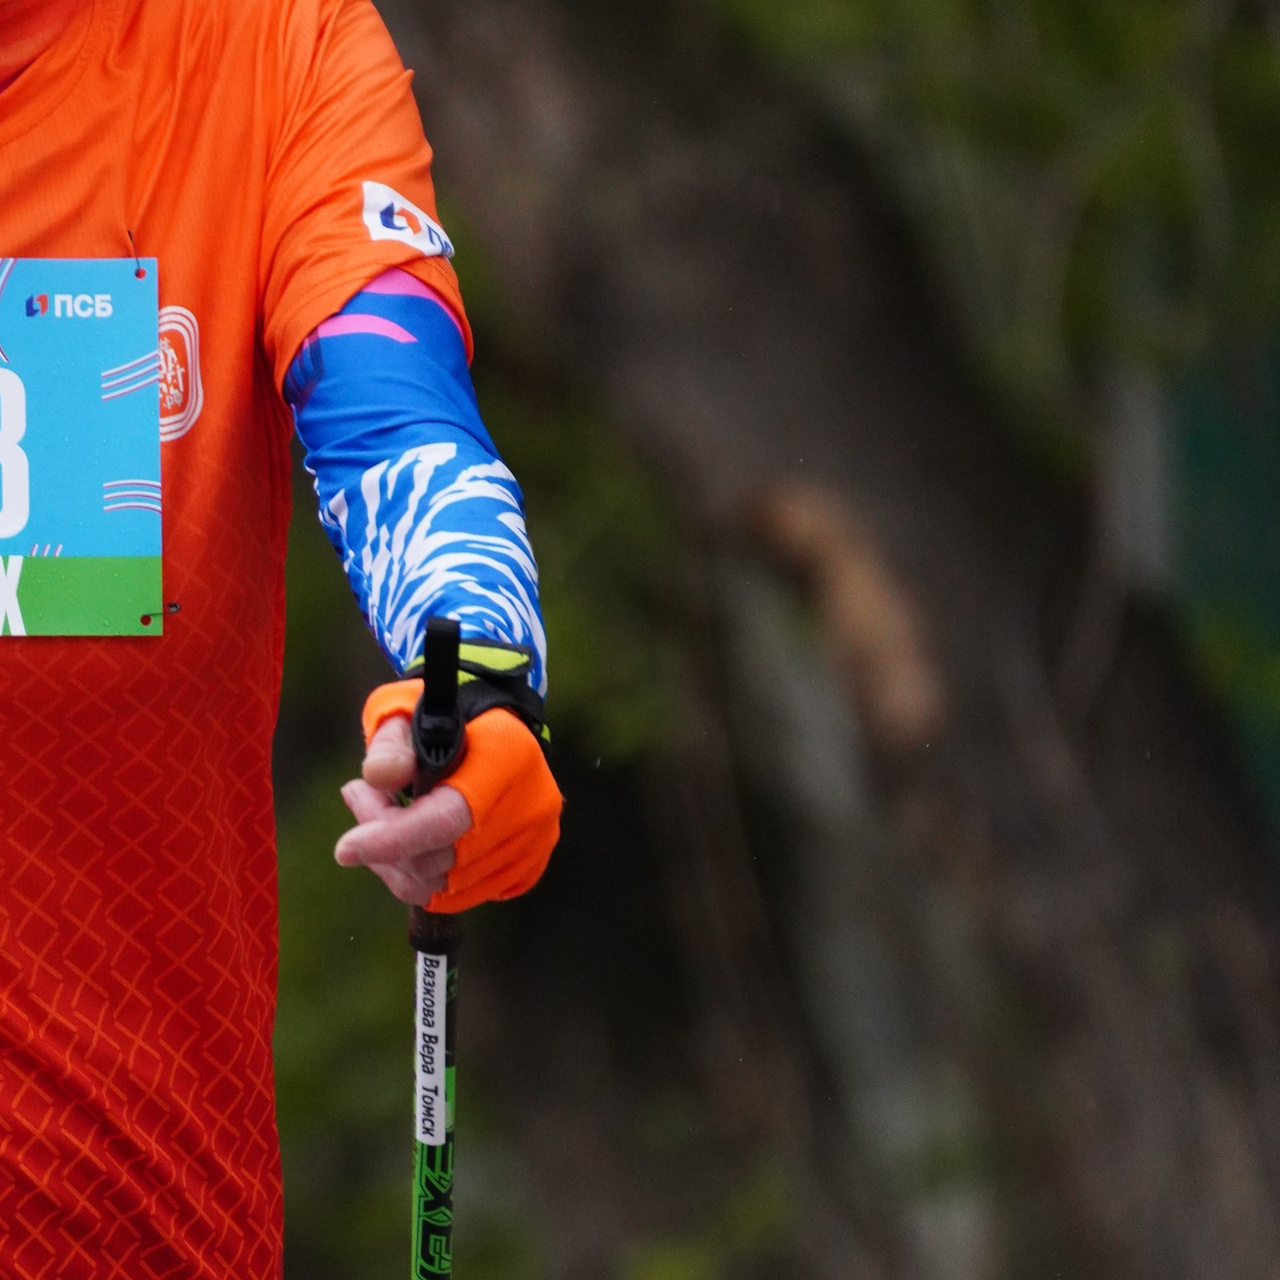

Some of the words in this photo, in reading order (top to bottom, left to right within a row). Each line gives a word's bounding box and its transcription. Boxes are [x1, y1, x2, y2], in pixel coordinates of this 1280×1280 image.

[54, 294, 113, 318] ПСБ
[421, 955, 440, 1029] Вязкова
[421, 1031, 439, 1076] Вера
[421, 1086, 439, 1138] Томск
